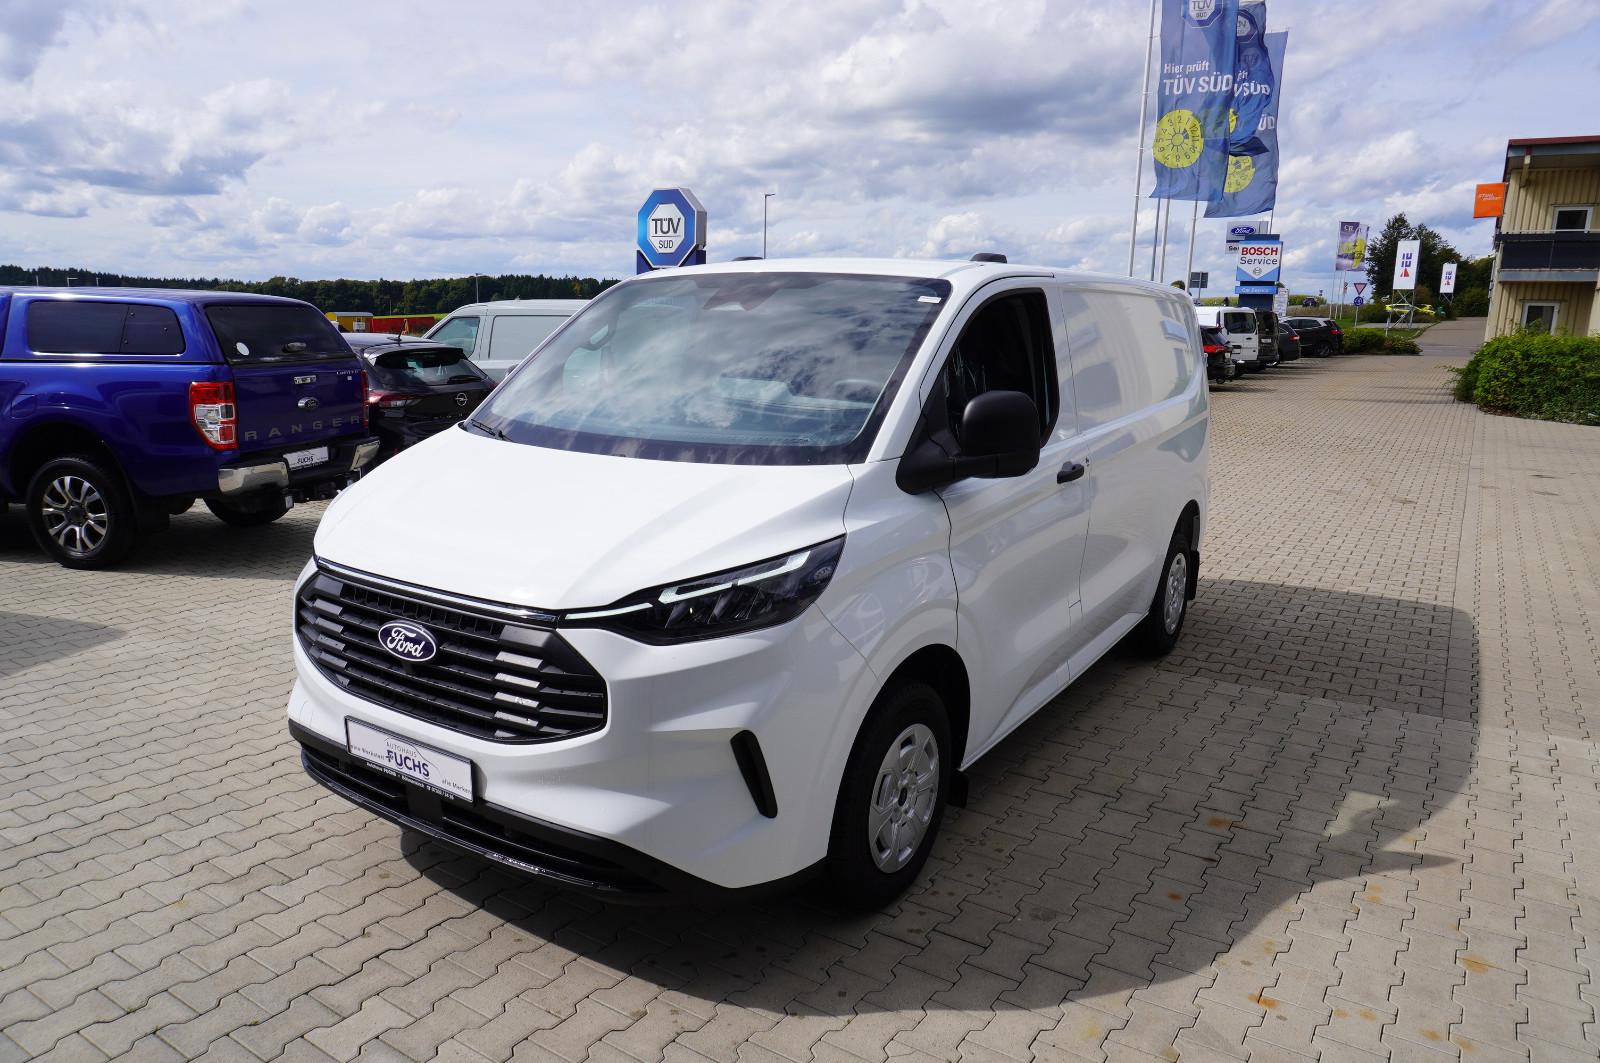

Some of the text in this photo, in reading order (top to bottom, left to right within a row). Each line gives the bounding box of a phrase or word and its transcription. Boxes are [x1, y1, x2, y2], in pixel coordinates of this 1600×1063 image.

[1164, 60, 1209, 74] Hier prüft
[1163, 74, 1196, 96] TÜV
[1198, 72, 1233, 93] SÜD
[1258, 114, 1275, 130] ÜD
[651, 217, 682, 235] TÜV
[1241, 246, 1279, 256] BOSCH
[1240, 256, 1278, 265] Service
[244, 415, 360, 441] RANGER
[297, 455, 314, 464] FUCHS
[386, 627, 426, 657] Ford
[386, 741, 417, 758] AUTOHAUS
[385, 749, 430, 778] FUCHS
